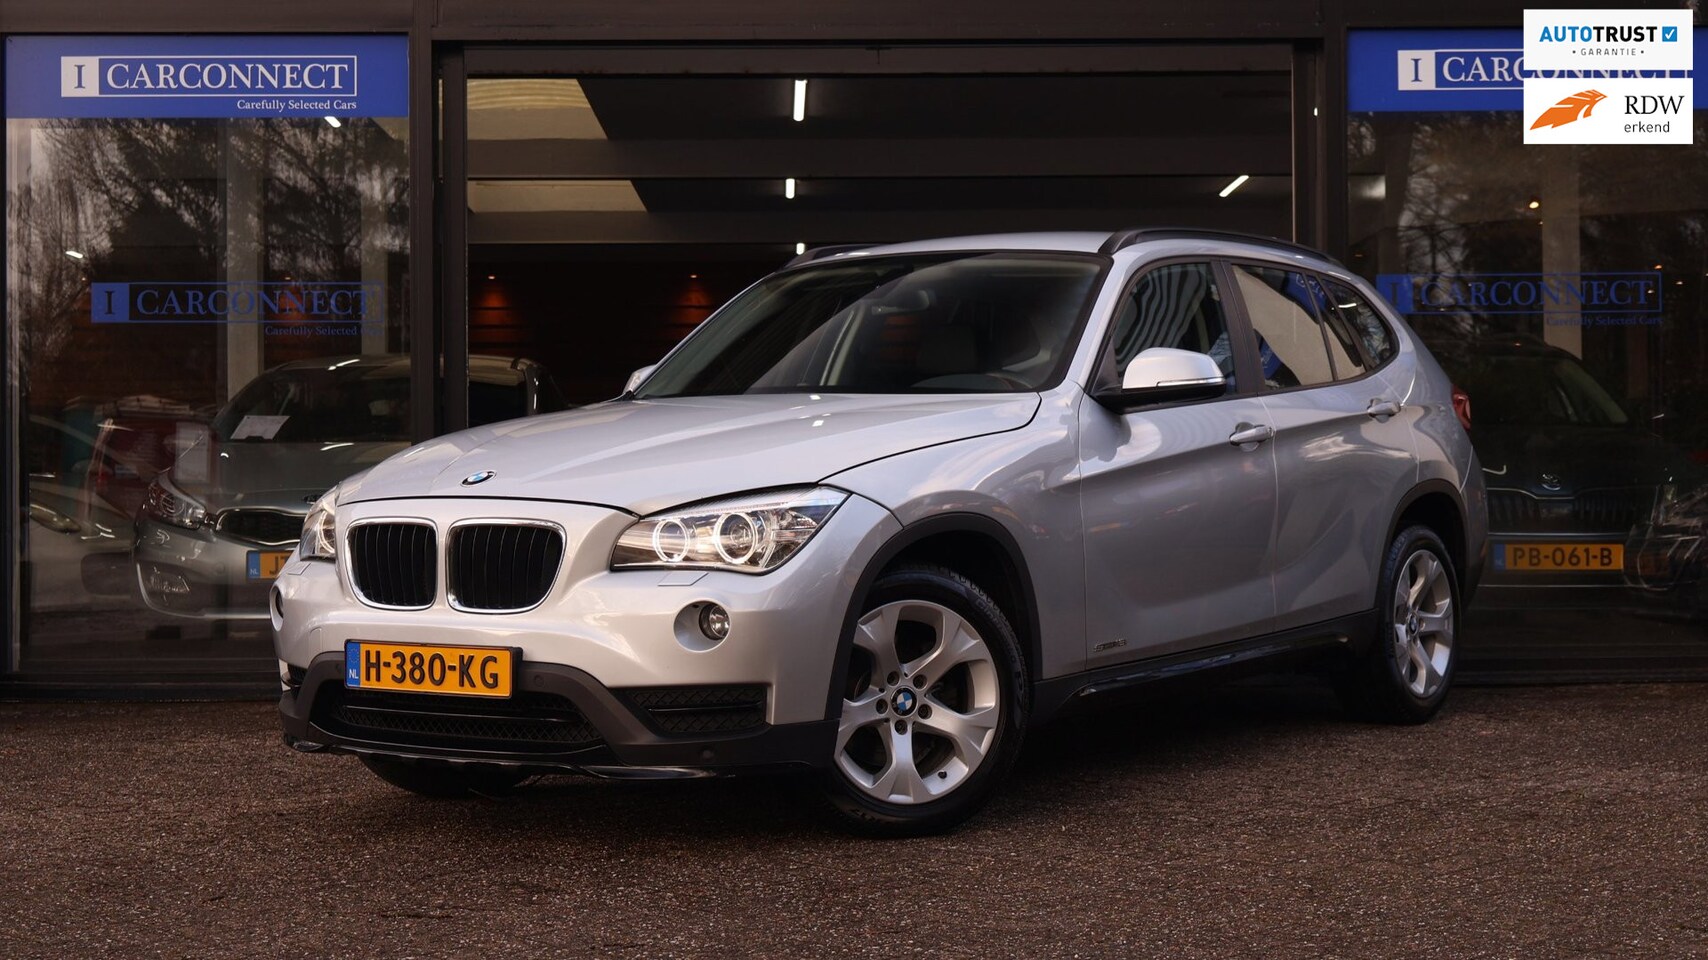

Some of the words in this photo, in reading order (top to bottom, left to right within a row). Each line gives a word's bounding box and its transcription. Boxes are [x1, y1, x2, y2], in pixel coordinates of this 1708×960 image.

[106, 63, 349, 90] CARCONNECT
[237, 100, 286, 113] Carefully
[288, 100, 331, 110] Selected
[333, 100, 357, 110] Cars
[136, 289, 376, 316] CARCONNECT
[1420, 280, 1655, 306] CARCONNECT
[265, 325, 313, 337] Carefully
[315, 325, 359, 336] Selected
[1513, 547, 1613, 567] PB-061-B
[348, 668, 359, 680] NL
[365, 649, 499, 690] H-380-KG
